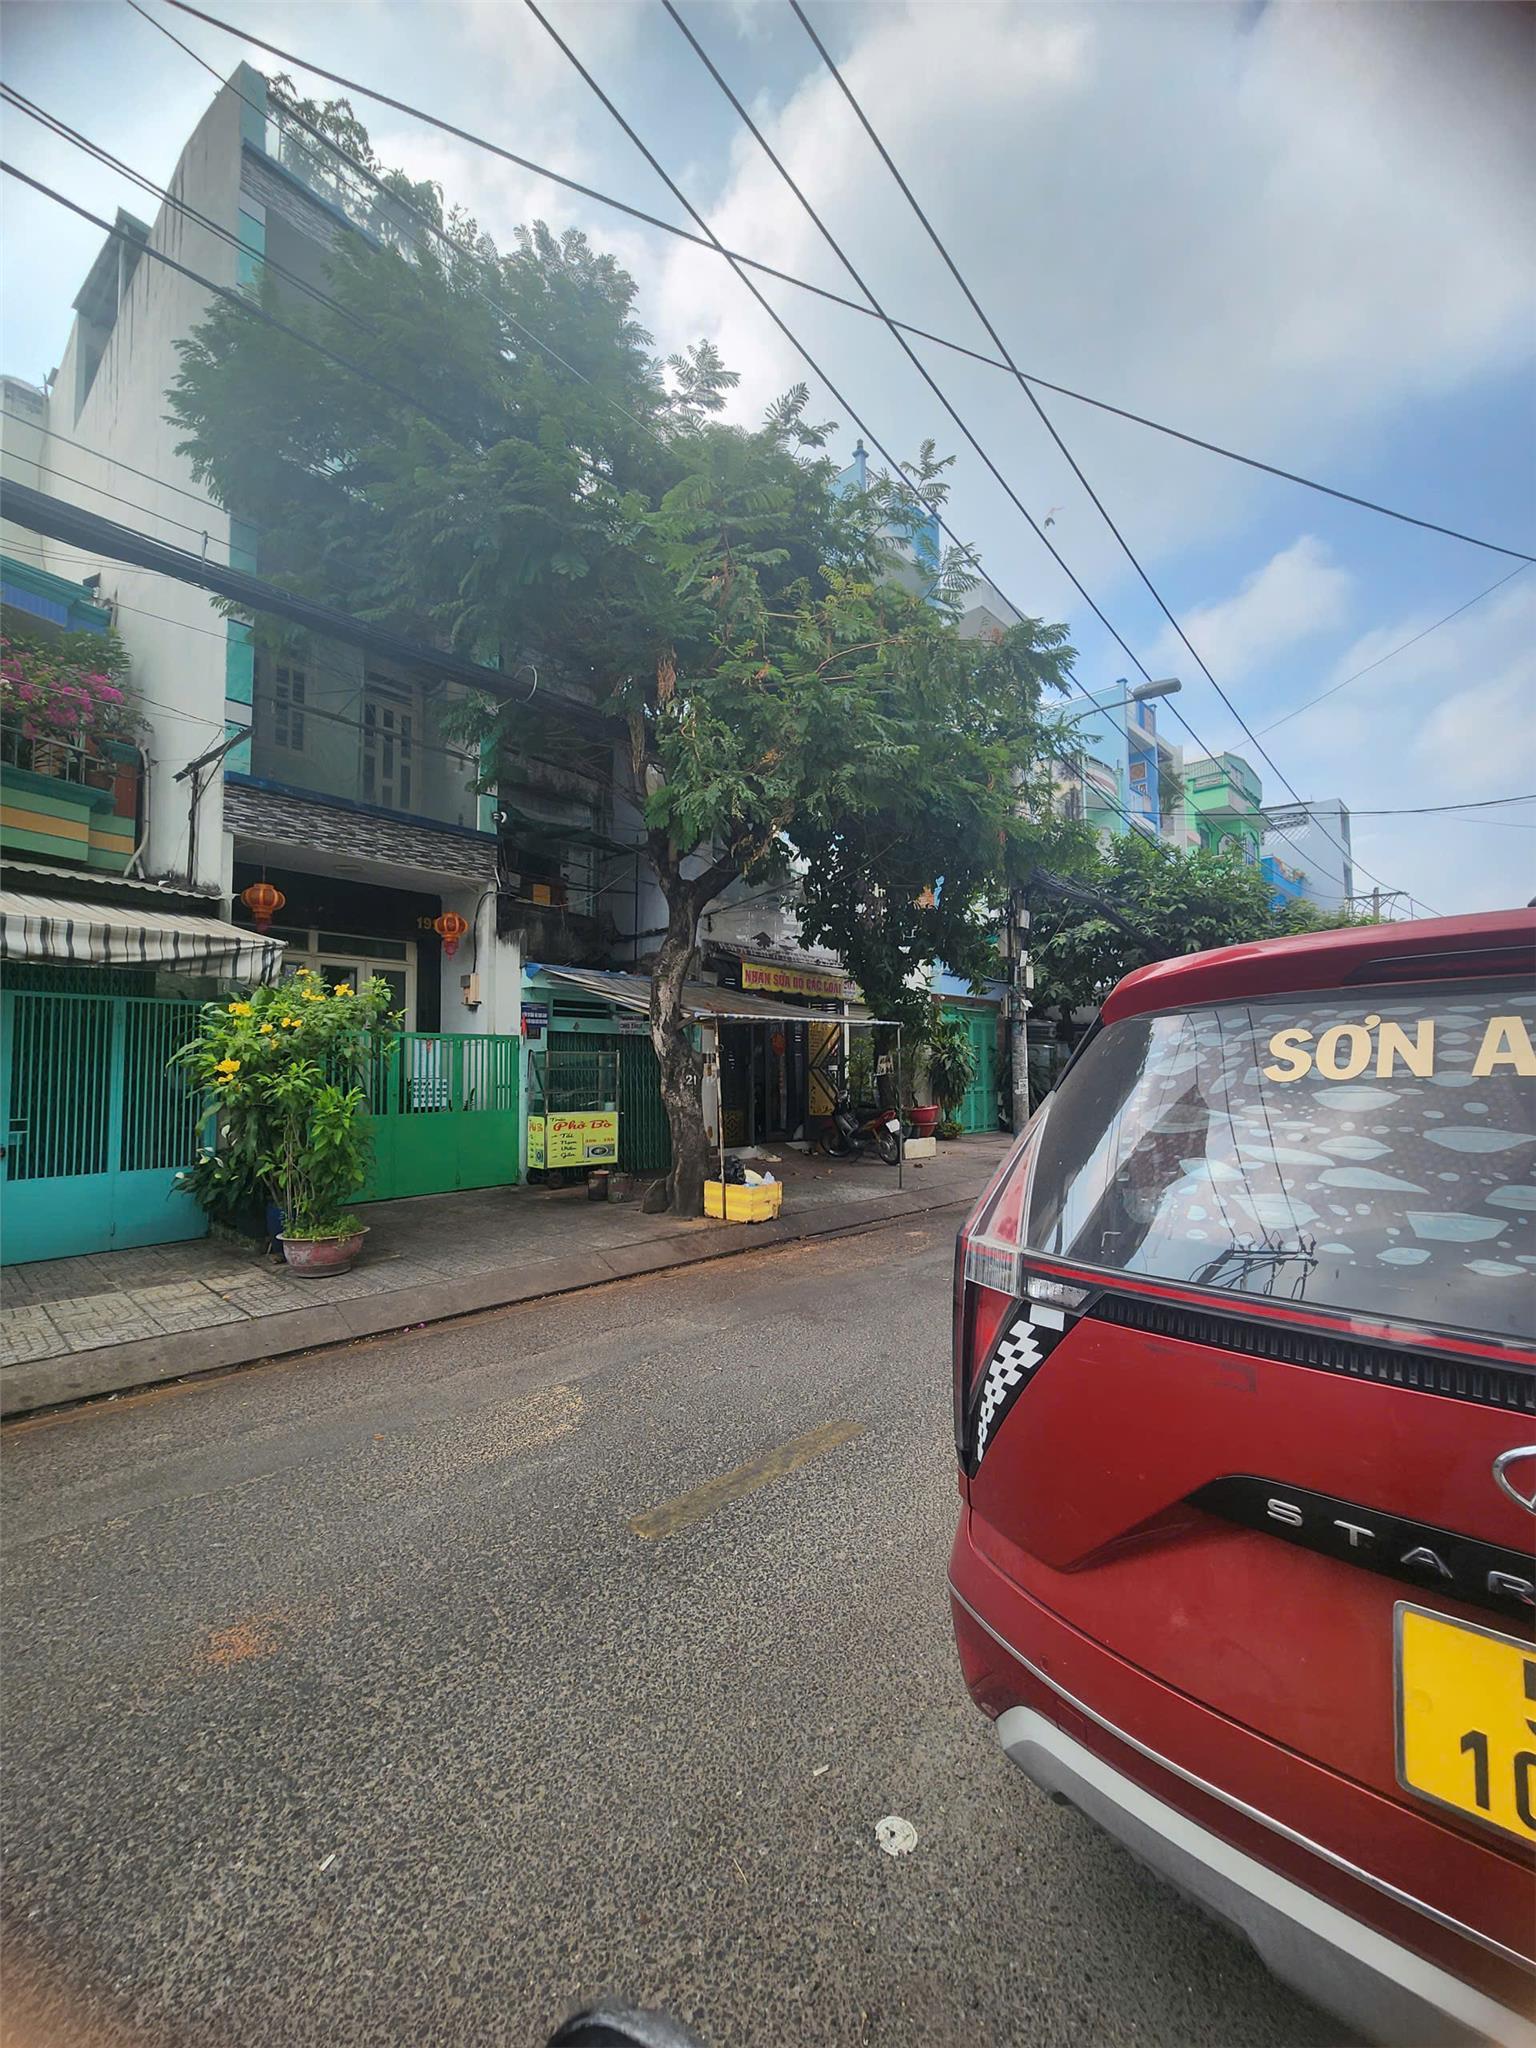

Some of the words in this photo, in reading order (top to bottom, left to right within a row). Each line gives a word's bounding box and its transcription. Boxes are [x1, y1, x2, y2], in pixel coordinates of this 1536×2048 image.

[1262, 1014, 1435, 1083] SƠN
[1471, 1016, 1536, 1077] A
[685, 1074, 697, 1086] 21
[553, 1120, 587, 1132] Phở
[590, 1119, 613, 1129] Bò
[1267, 1498, 1536, 1605] STAR
